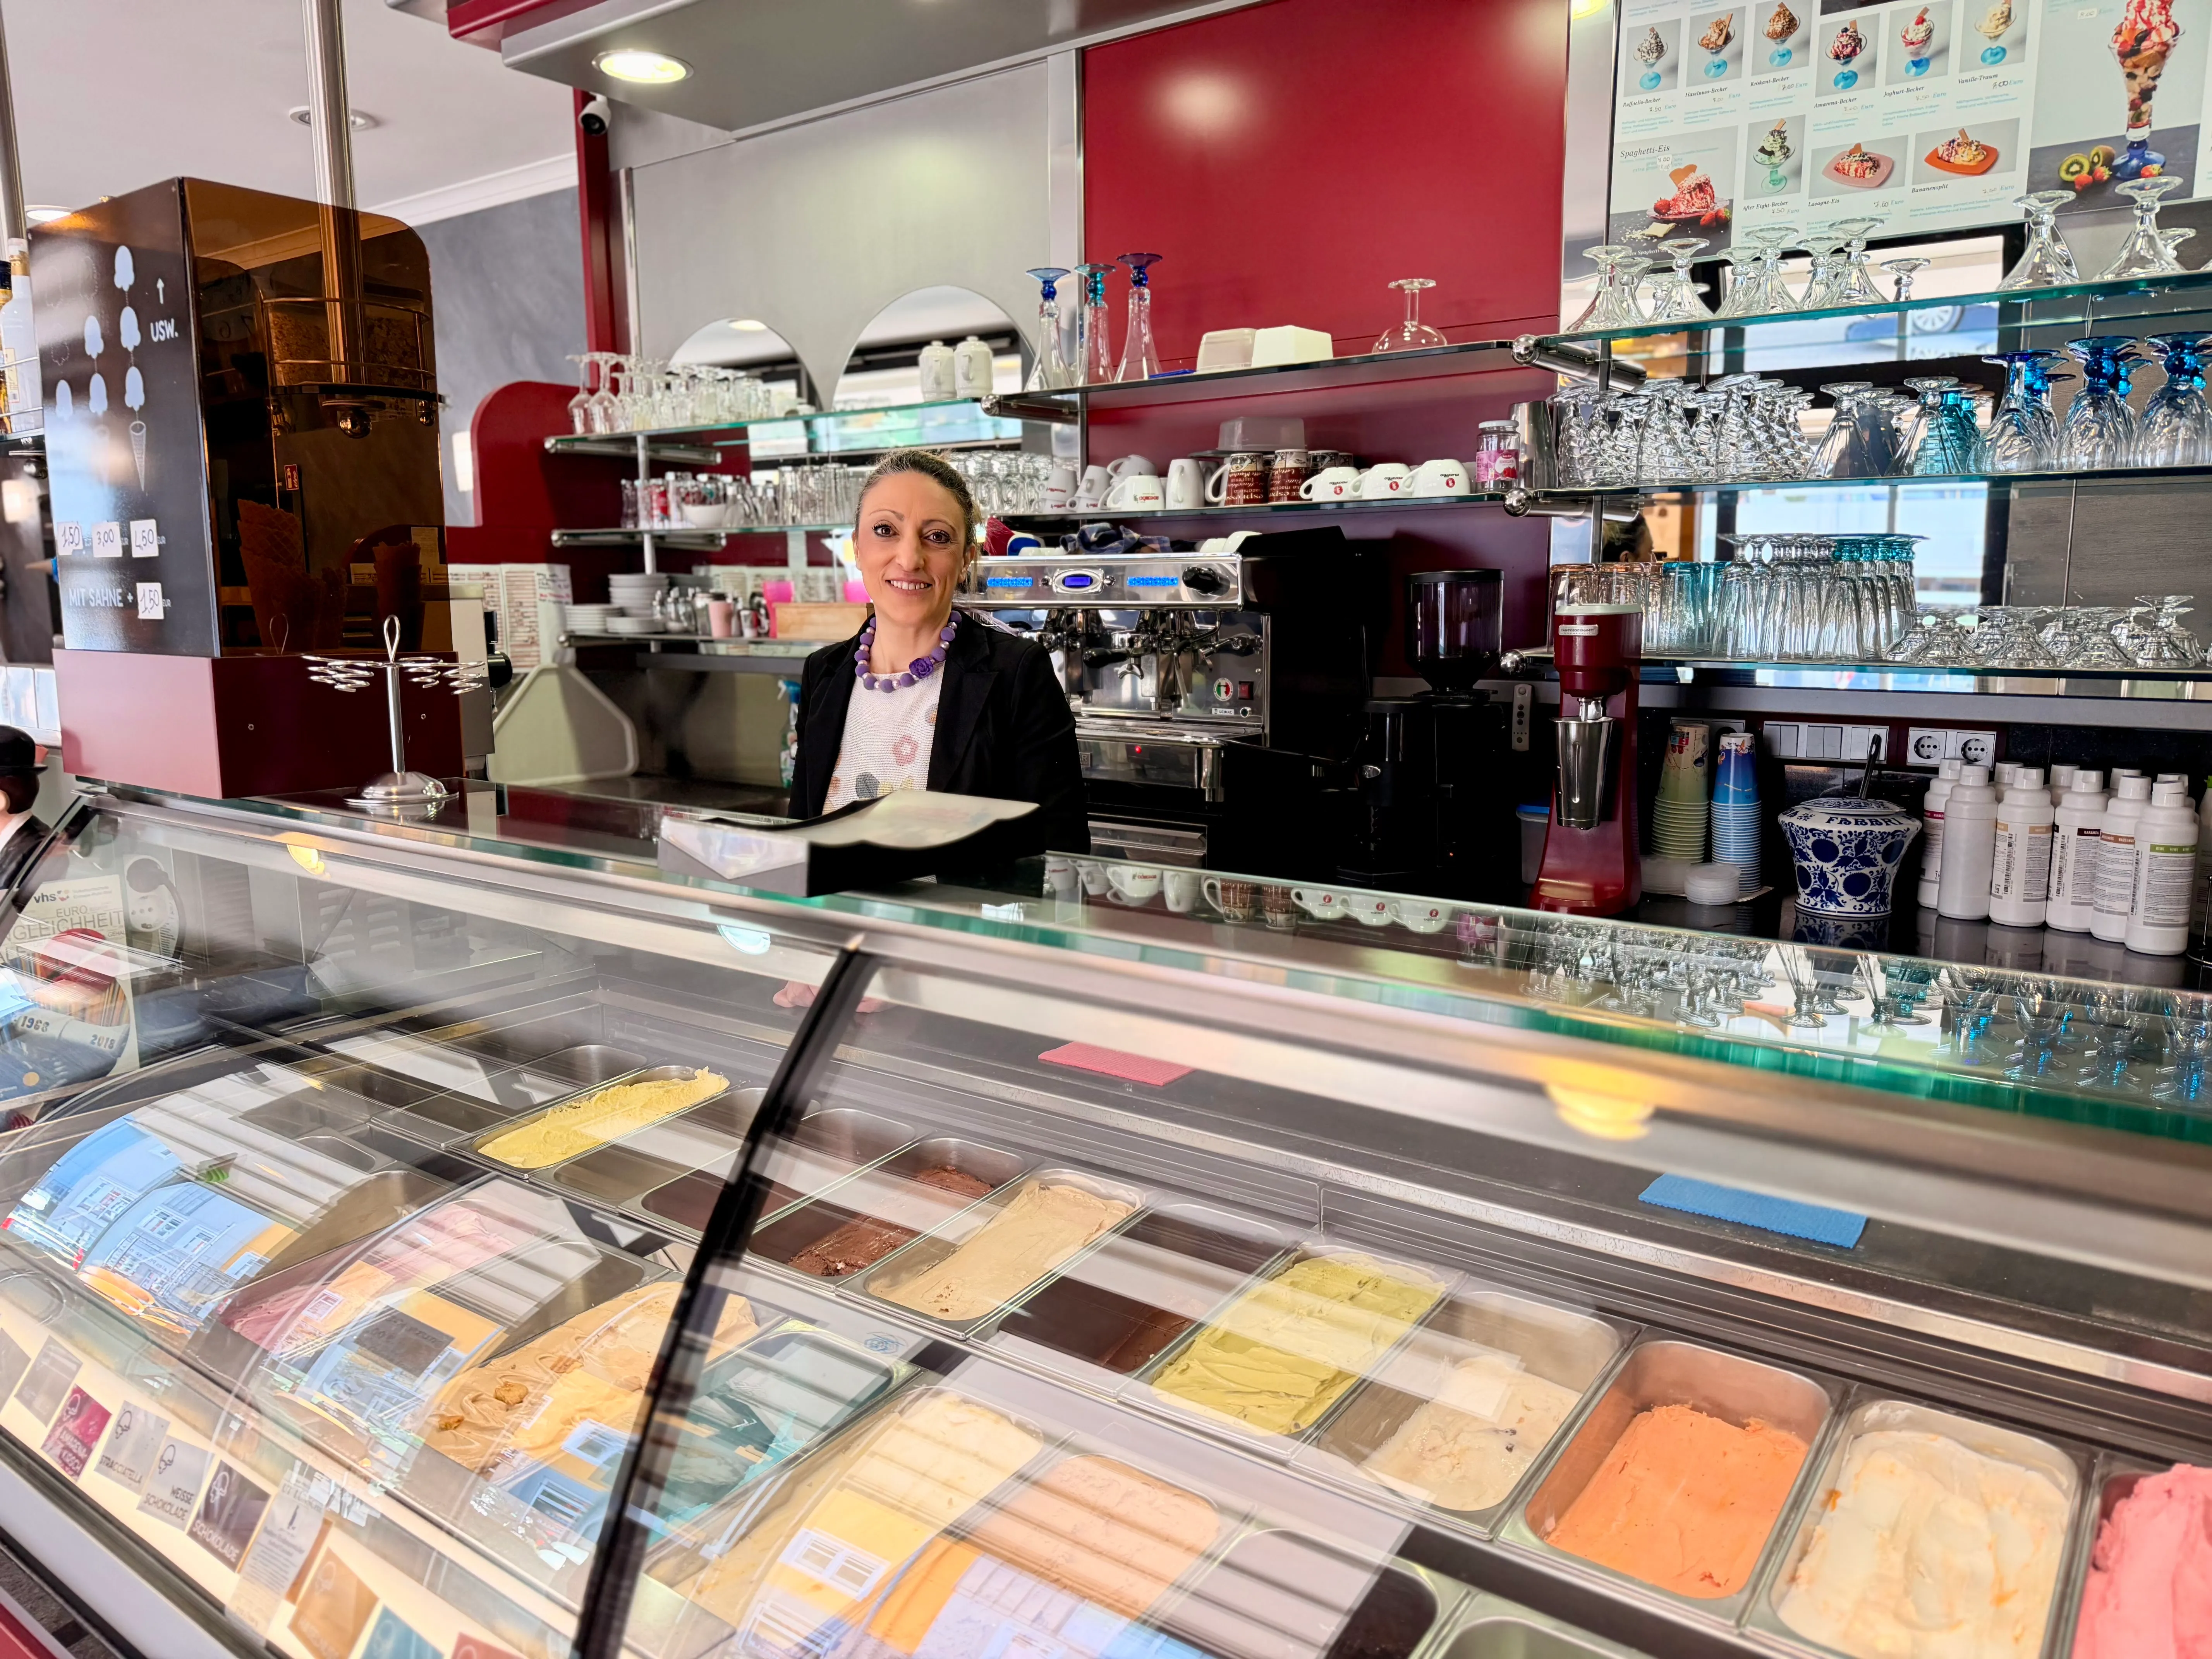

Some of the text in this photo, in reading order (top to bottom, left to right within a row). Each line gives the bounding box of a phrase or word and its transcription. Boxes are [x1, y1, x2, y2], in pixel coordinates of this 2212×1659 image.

[1750, 76, 1790, 87] Krokant-Becher
[1958, 74, 1998, 84] Vanille-Traum
[1685, 86, 1728, 97] Haselnuss-Becher
[1883, 86, 1925, 97] Joghurt-Becher
[1623, 98, 1661, 108] Raffaello-Becher
[1814, 97, 1857, 108] Amarena-Becher
[1620, 144, 1670, 159] Spaghetti-Eis
[1911, 184, 1948, 193] Bananensplit
[1756, 201, 1789, 210] Eight-Becher
[1808, 199, 1839, 207] Lasagne-Eis
[150, 318, 179, 342] USW.
[61, 525, 80, 548] 1,50
[96, 528, 114, 547] 3,00
[69, 587, 86, 606] MIT
[89, 588, 124, 607] SAHNE
[140, 588, 160, 614] 1,50
[1825, 816, 1904, 826] FABBRI
[34, 892, 57, 903] vhs
[56, 905, 88, 918] EURO
[21, 1015, 50, 1033] 1968
[89, 1034, 116, 1050] 2018
[170, 1485, 195, 1505] WEISSE
[143, 1492, 188, 1521] SCHOKOLADE
[192, 1519, 240, 1563] SCHOKOLADE
